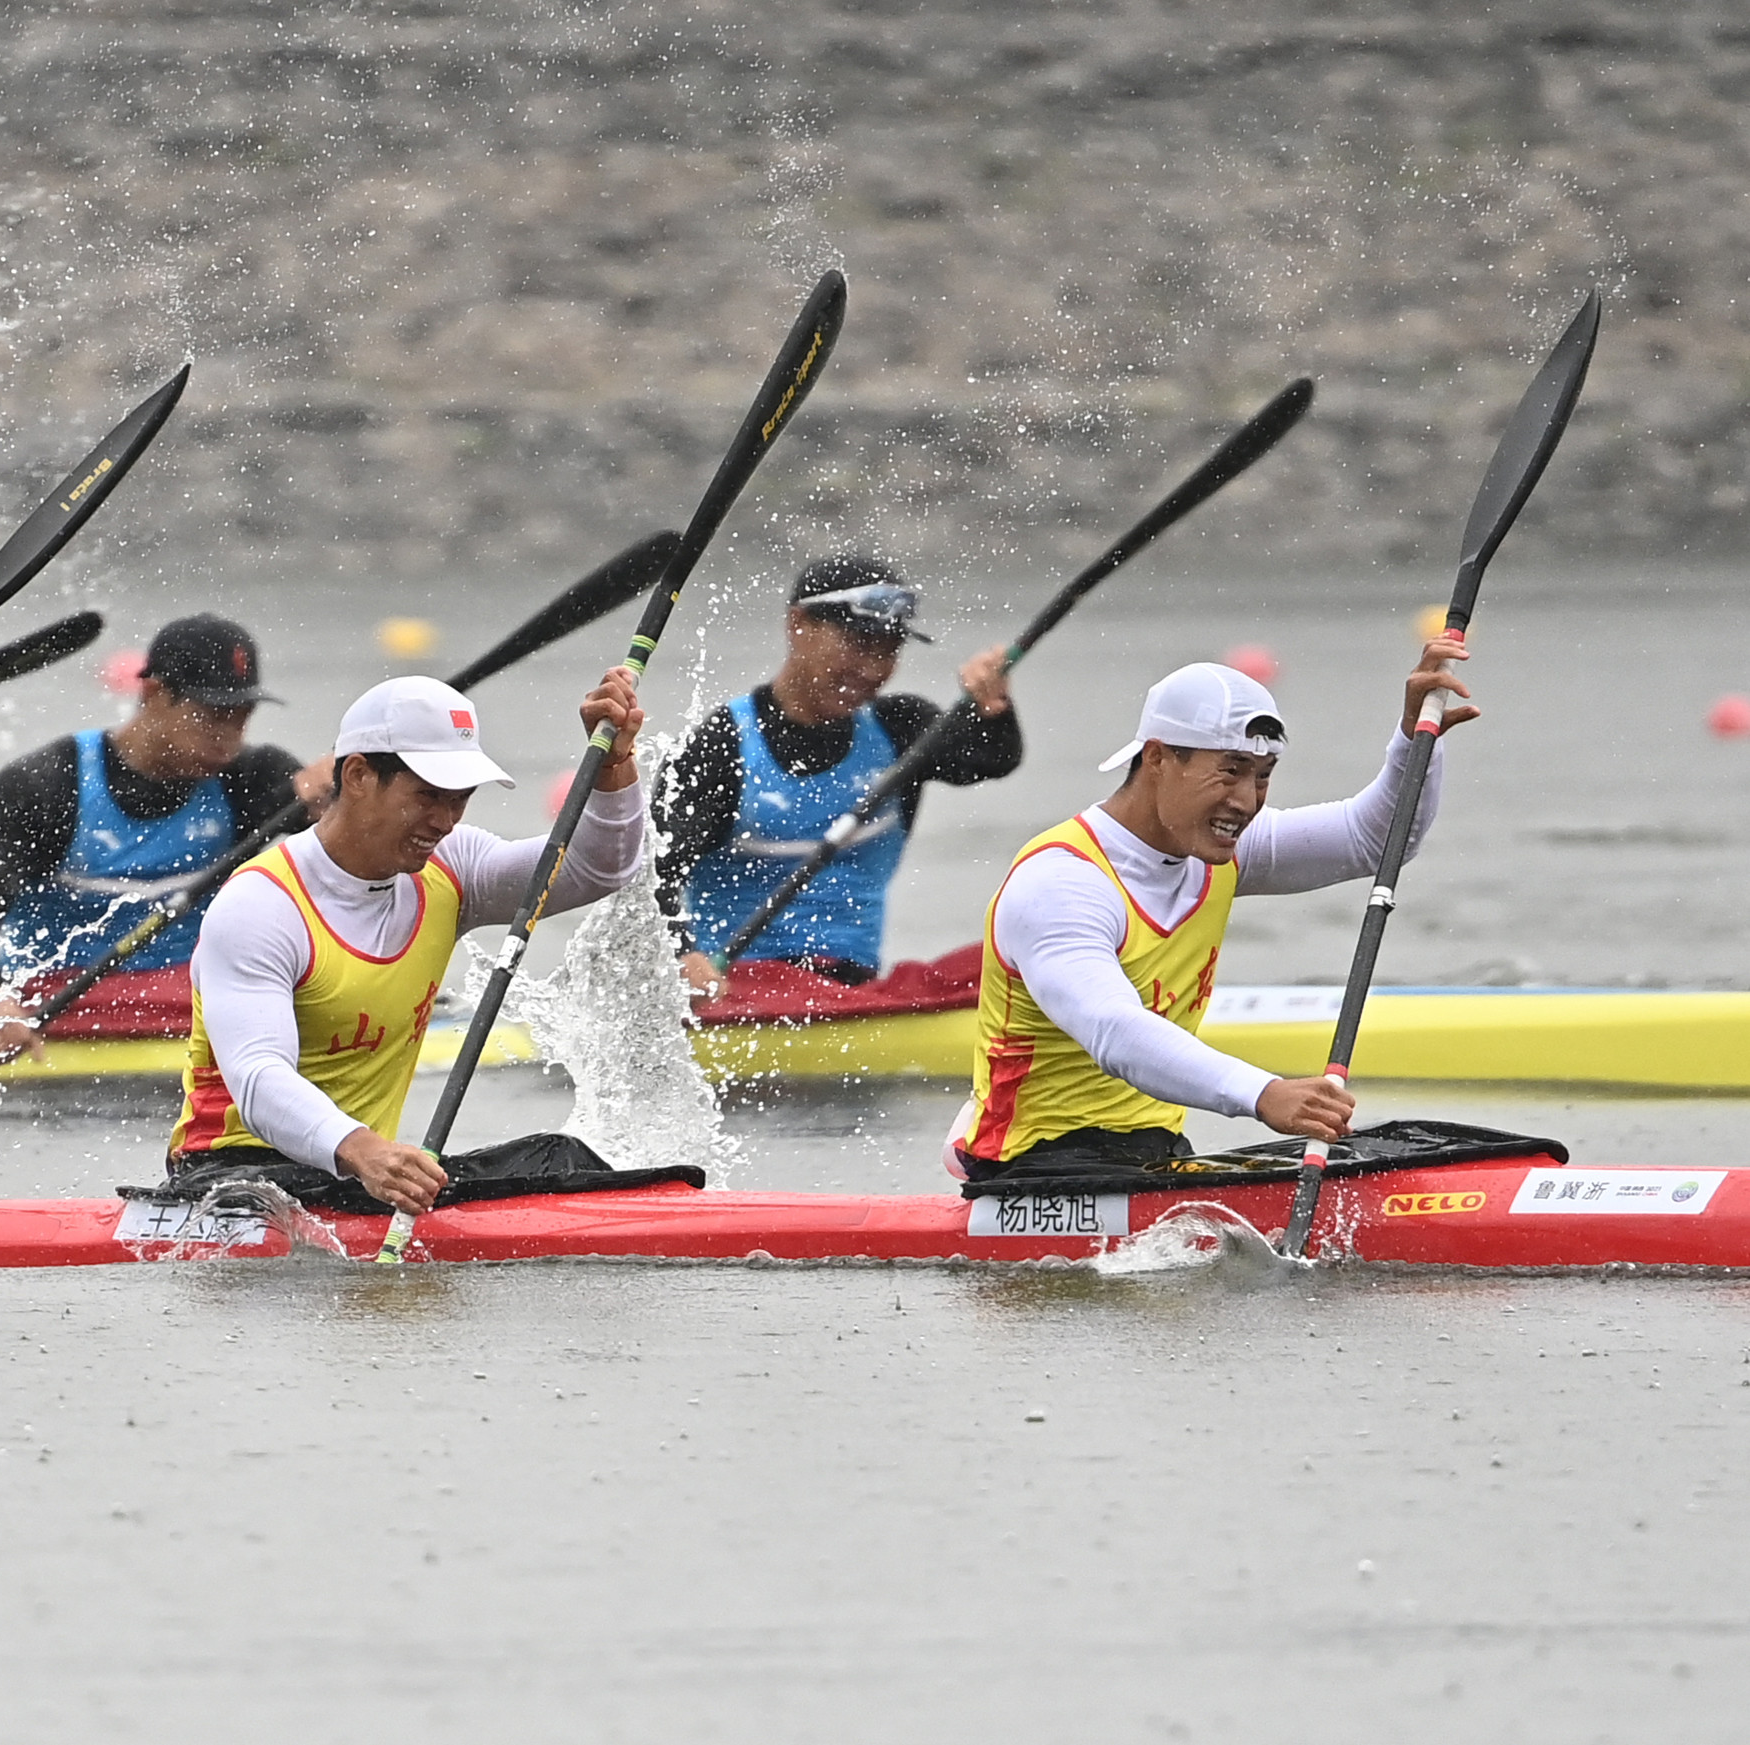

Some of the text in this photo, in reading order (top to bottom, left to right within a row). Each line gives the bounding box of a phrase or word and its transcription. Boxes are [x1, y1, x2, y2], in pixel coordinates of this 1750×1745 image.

[995, 1193, 1100, 1234] 杨晓旭
[1388, 1195, 1482, 1213] NELO
